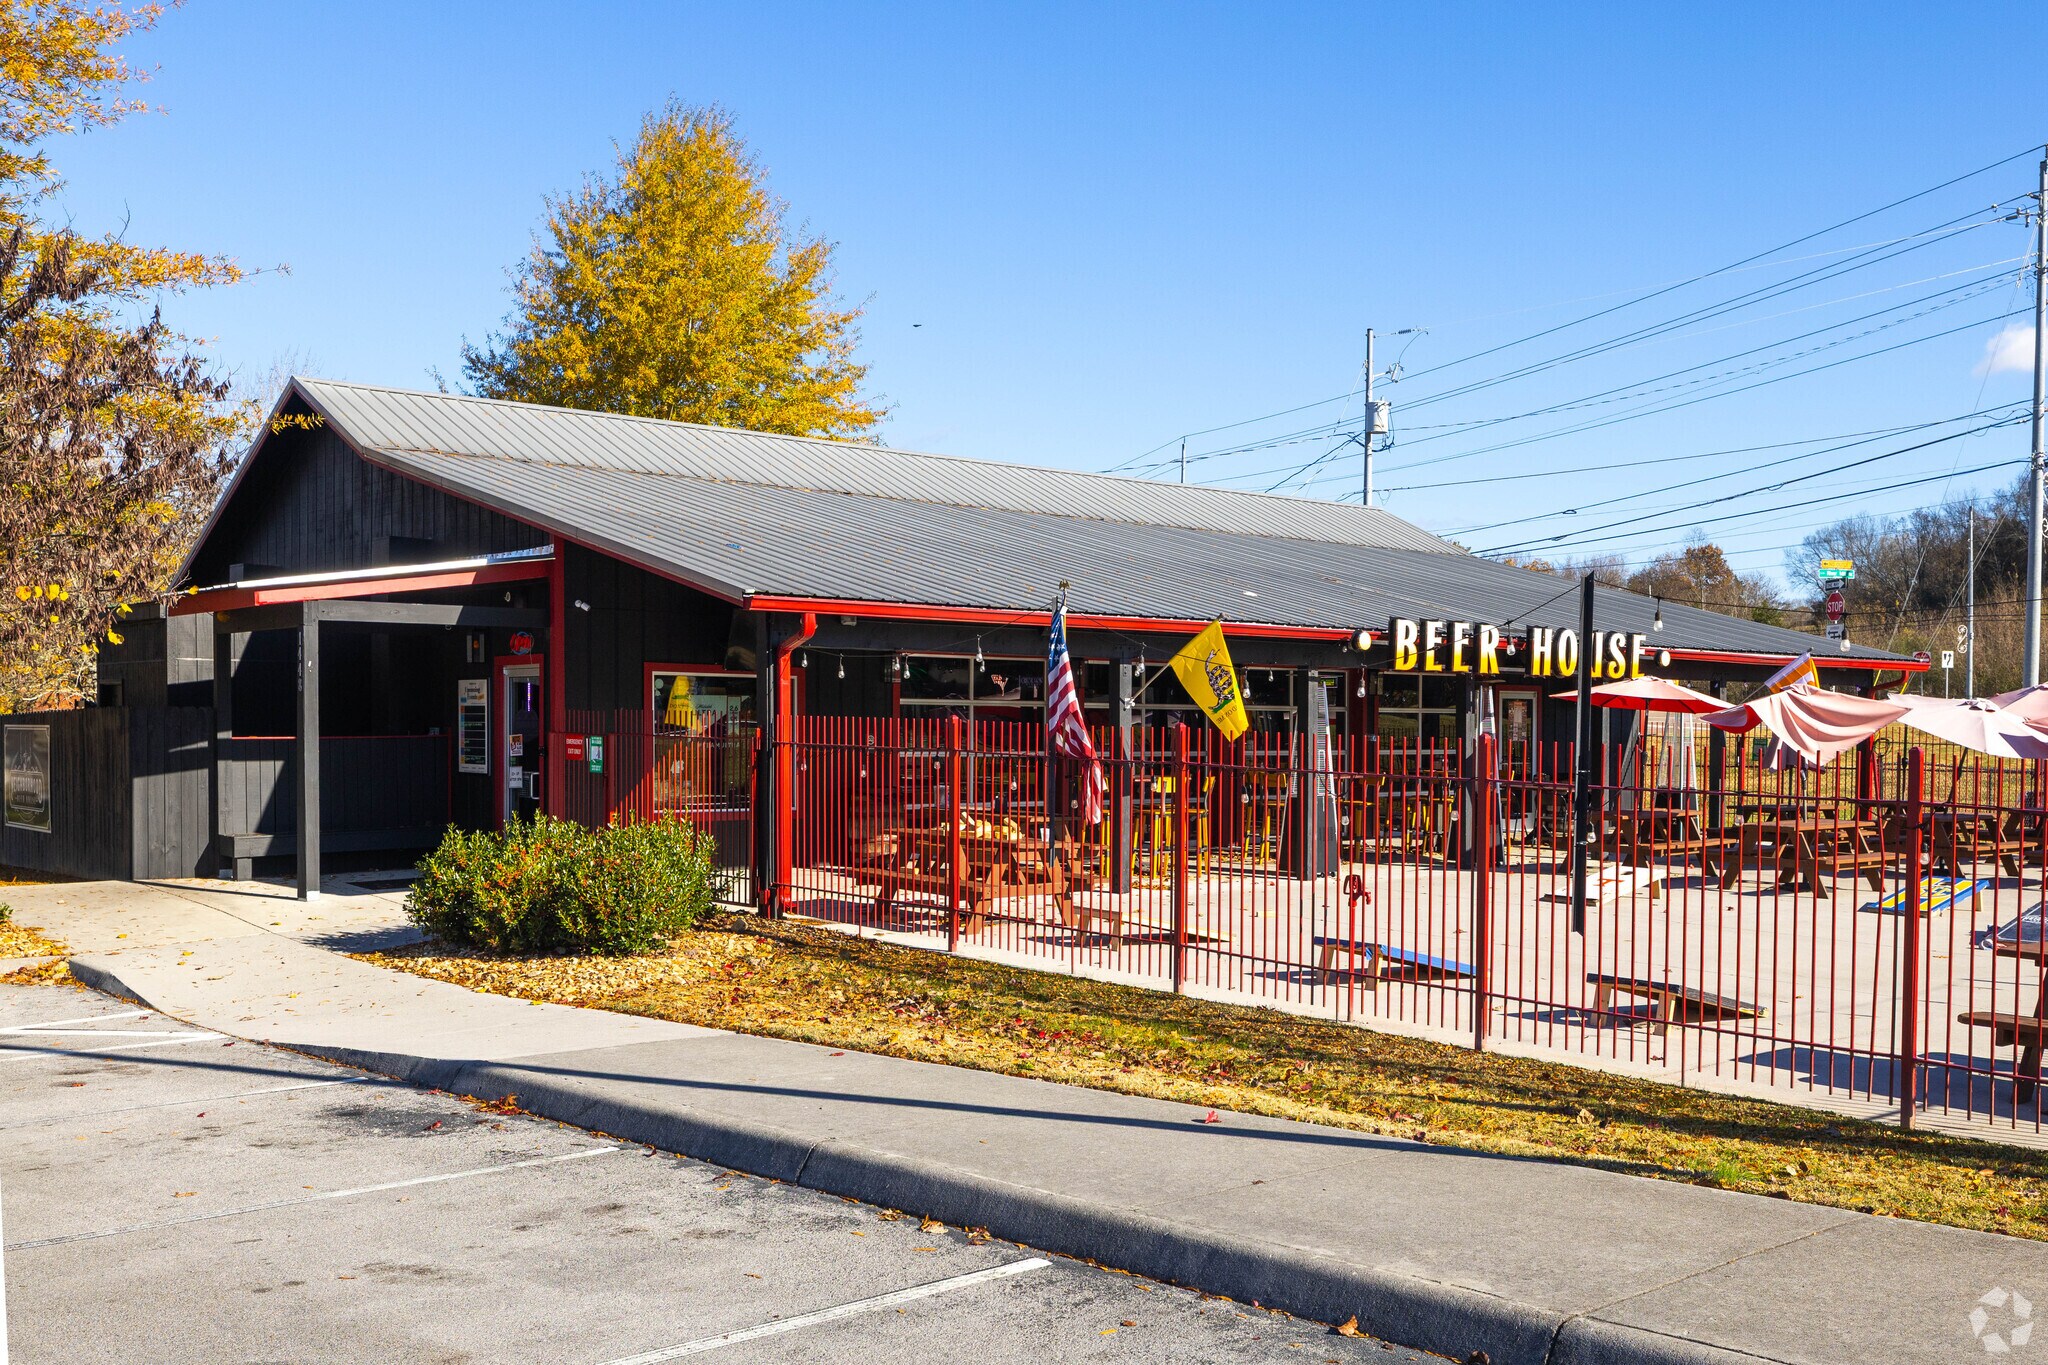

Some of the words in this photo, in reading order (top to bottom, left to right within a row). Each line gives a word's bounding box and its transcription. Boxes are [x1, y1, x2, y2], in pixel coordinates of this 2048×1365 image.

[1827, 601, 1843, 613] STOP
[1395, 618, 1500, 674] BEER
[1532, 627, 1648, 679] HOUSE
